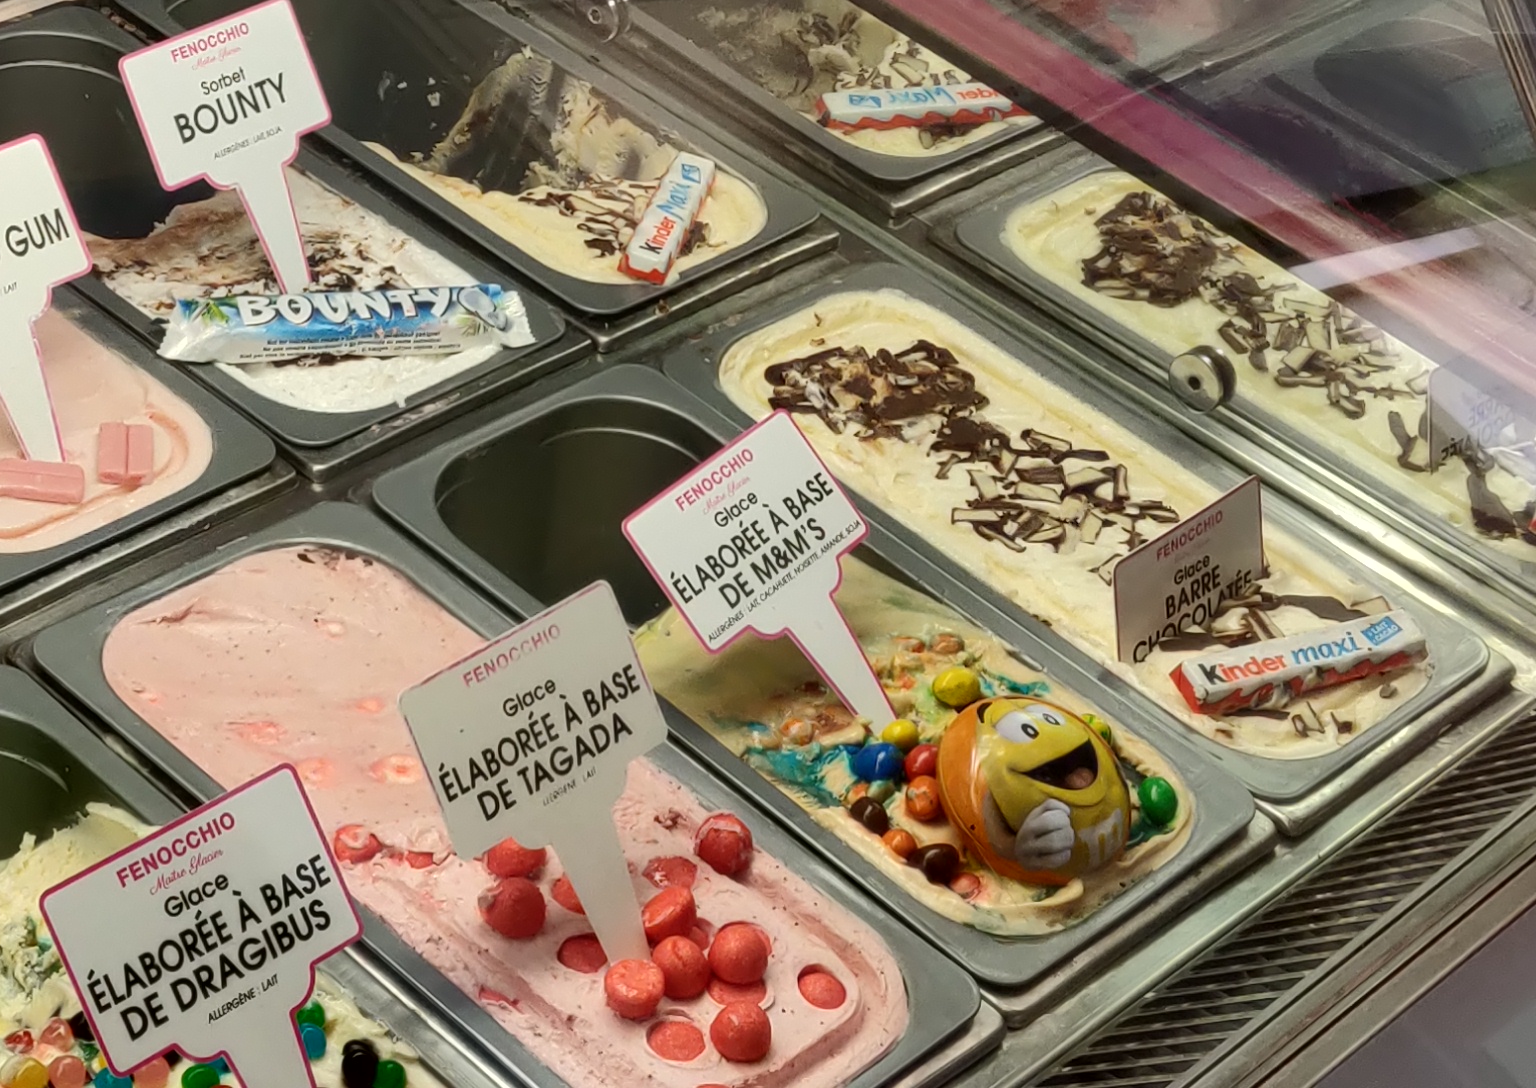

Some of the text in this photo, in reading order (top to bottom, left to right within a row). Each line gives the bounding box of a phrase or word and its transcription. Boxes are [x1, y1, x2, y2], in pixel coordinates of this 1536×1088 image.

[170, 22, 250, 63] FENOCCHIO
[200, 66, 246, 96] Sorbet
[173, 72, 286, 145] BOUNTY
[5, 208, 70, 257] GUM
[235, 287, 452, 326] BOUNTY
[675, 448, 754, 512] FENOCCHIO
[714, 492, 758, 527] Glace
[670, 472, 834, 604] ÉLABORÉE À BASE
[1155, 511, 1224, 561] FENOCCHIO
[718, 572, 755, 609] DE
[1165, 564, 1221, 619] BARRE
[1174, 555, 1210, 585] Glace
[462, 623, 561, 688] FENOCCHIO
[1291, 632, 1363, 666] maxi
[502, 679, 556, 717] Glace
[438, 664, 641, 803] ÉLABORÉE À BASE
[476, 712, 633, 822] DE TAGADA
[116, 812, 235, 889] FENOCCHIO
[163, 874, 230, 918] Glace
[86, 854, 332, 1014] ÉLABORÉE À BASE
[119, 899, 332, 1042] DE DRAGIBUS
[261, 974, 279, 992] LAIT
